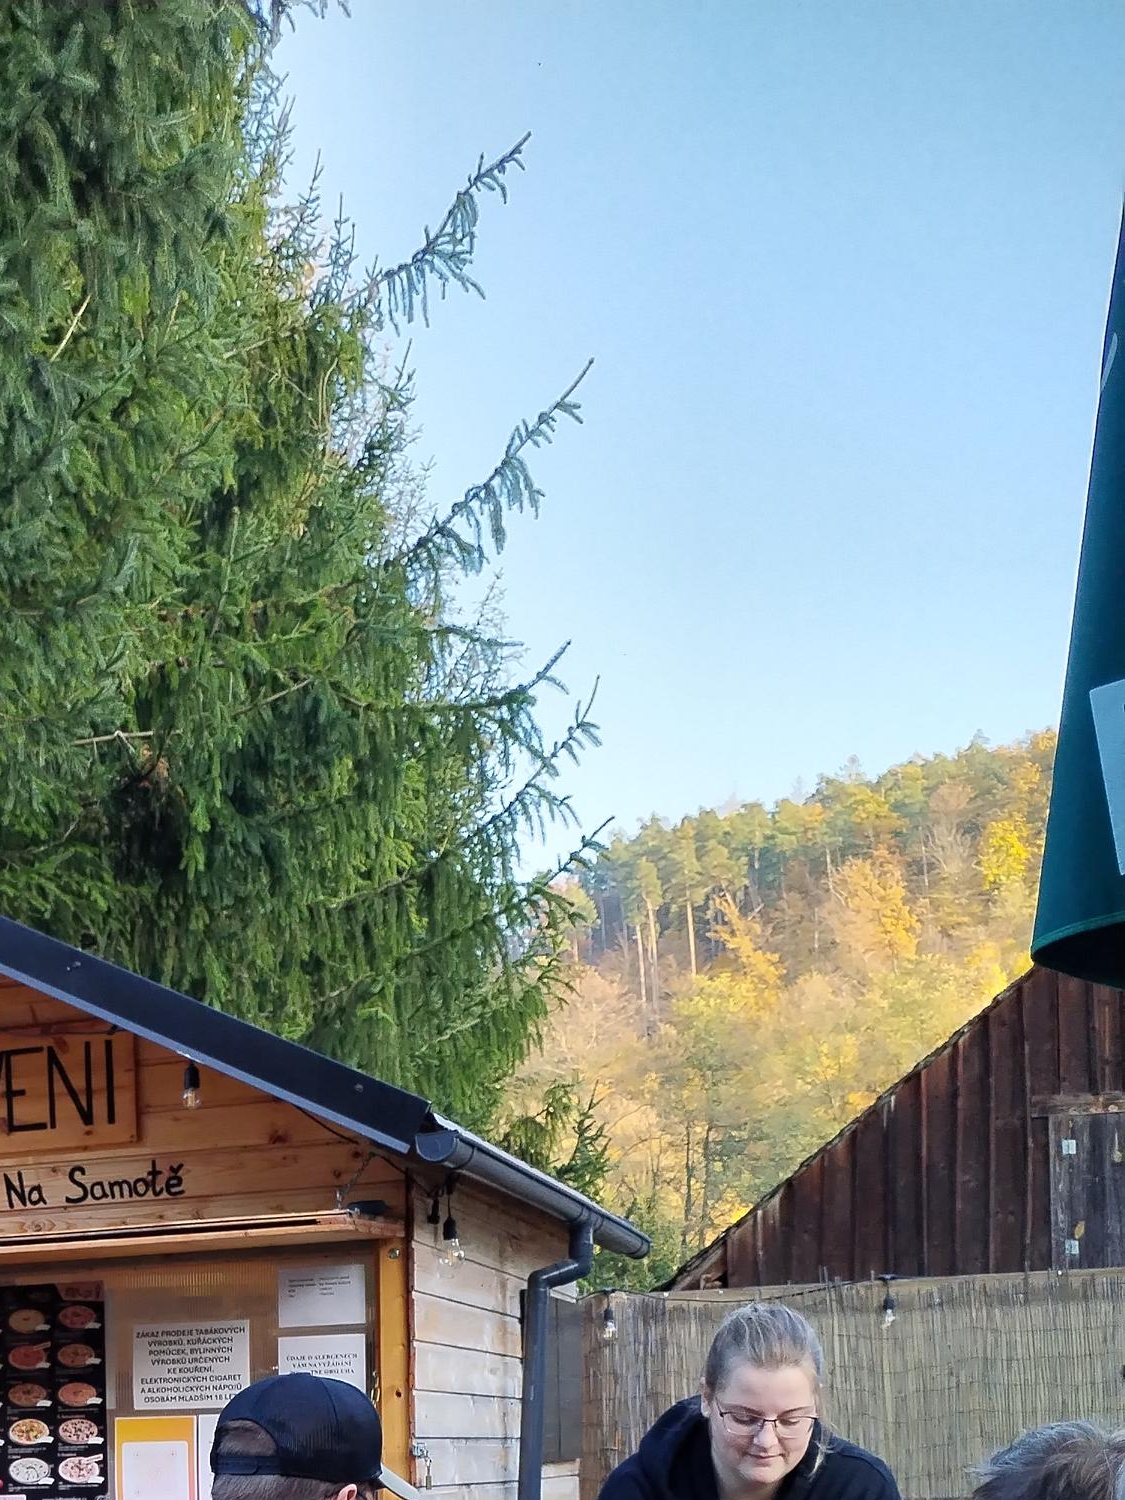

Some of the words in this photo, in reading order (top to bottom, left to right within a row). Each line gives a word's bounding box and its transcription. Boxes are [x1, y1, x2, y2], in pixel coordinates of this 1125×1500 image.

[3, 1170, 47, 1209] Na
[65, 1159, 186, 1204] Samotě
[136, 1330, 159, 1338] ZÁKAZ
[161, 1328, 194, 1338] PRODEJE
[195, 1326, 245, 1336] TABÁKOVÝCH
[187, 1336, 233, 1346] KUŘÁCKÝCH
[190, 1345, 232, 1355] BYLINNÝCH
[151, 1356, 186, 1366] VÝROBKŮ
[188, 1355, 230, 1364] URČENÝCH
[140, 1375, 208, 1385] ELEKTRONICKÝCH
[209, 1374, 241, 1382] CIGARET
[147, 1384, 211, 1393] ALKOHOLICKÝCH
[212, 1382, 242, 1391] NÁPOJŮ
[144, 1394, 177, 1403] OSOBÁM
[178, 1393, 213, 1402] MLADŠÍM
